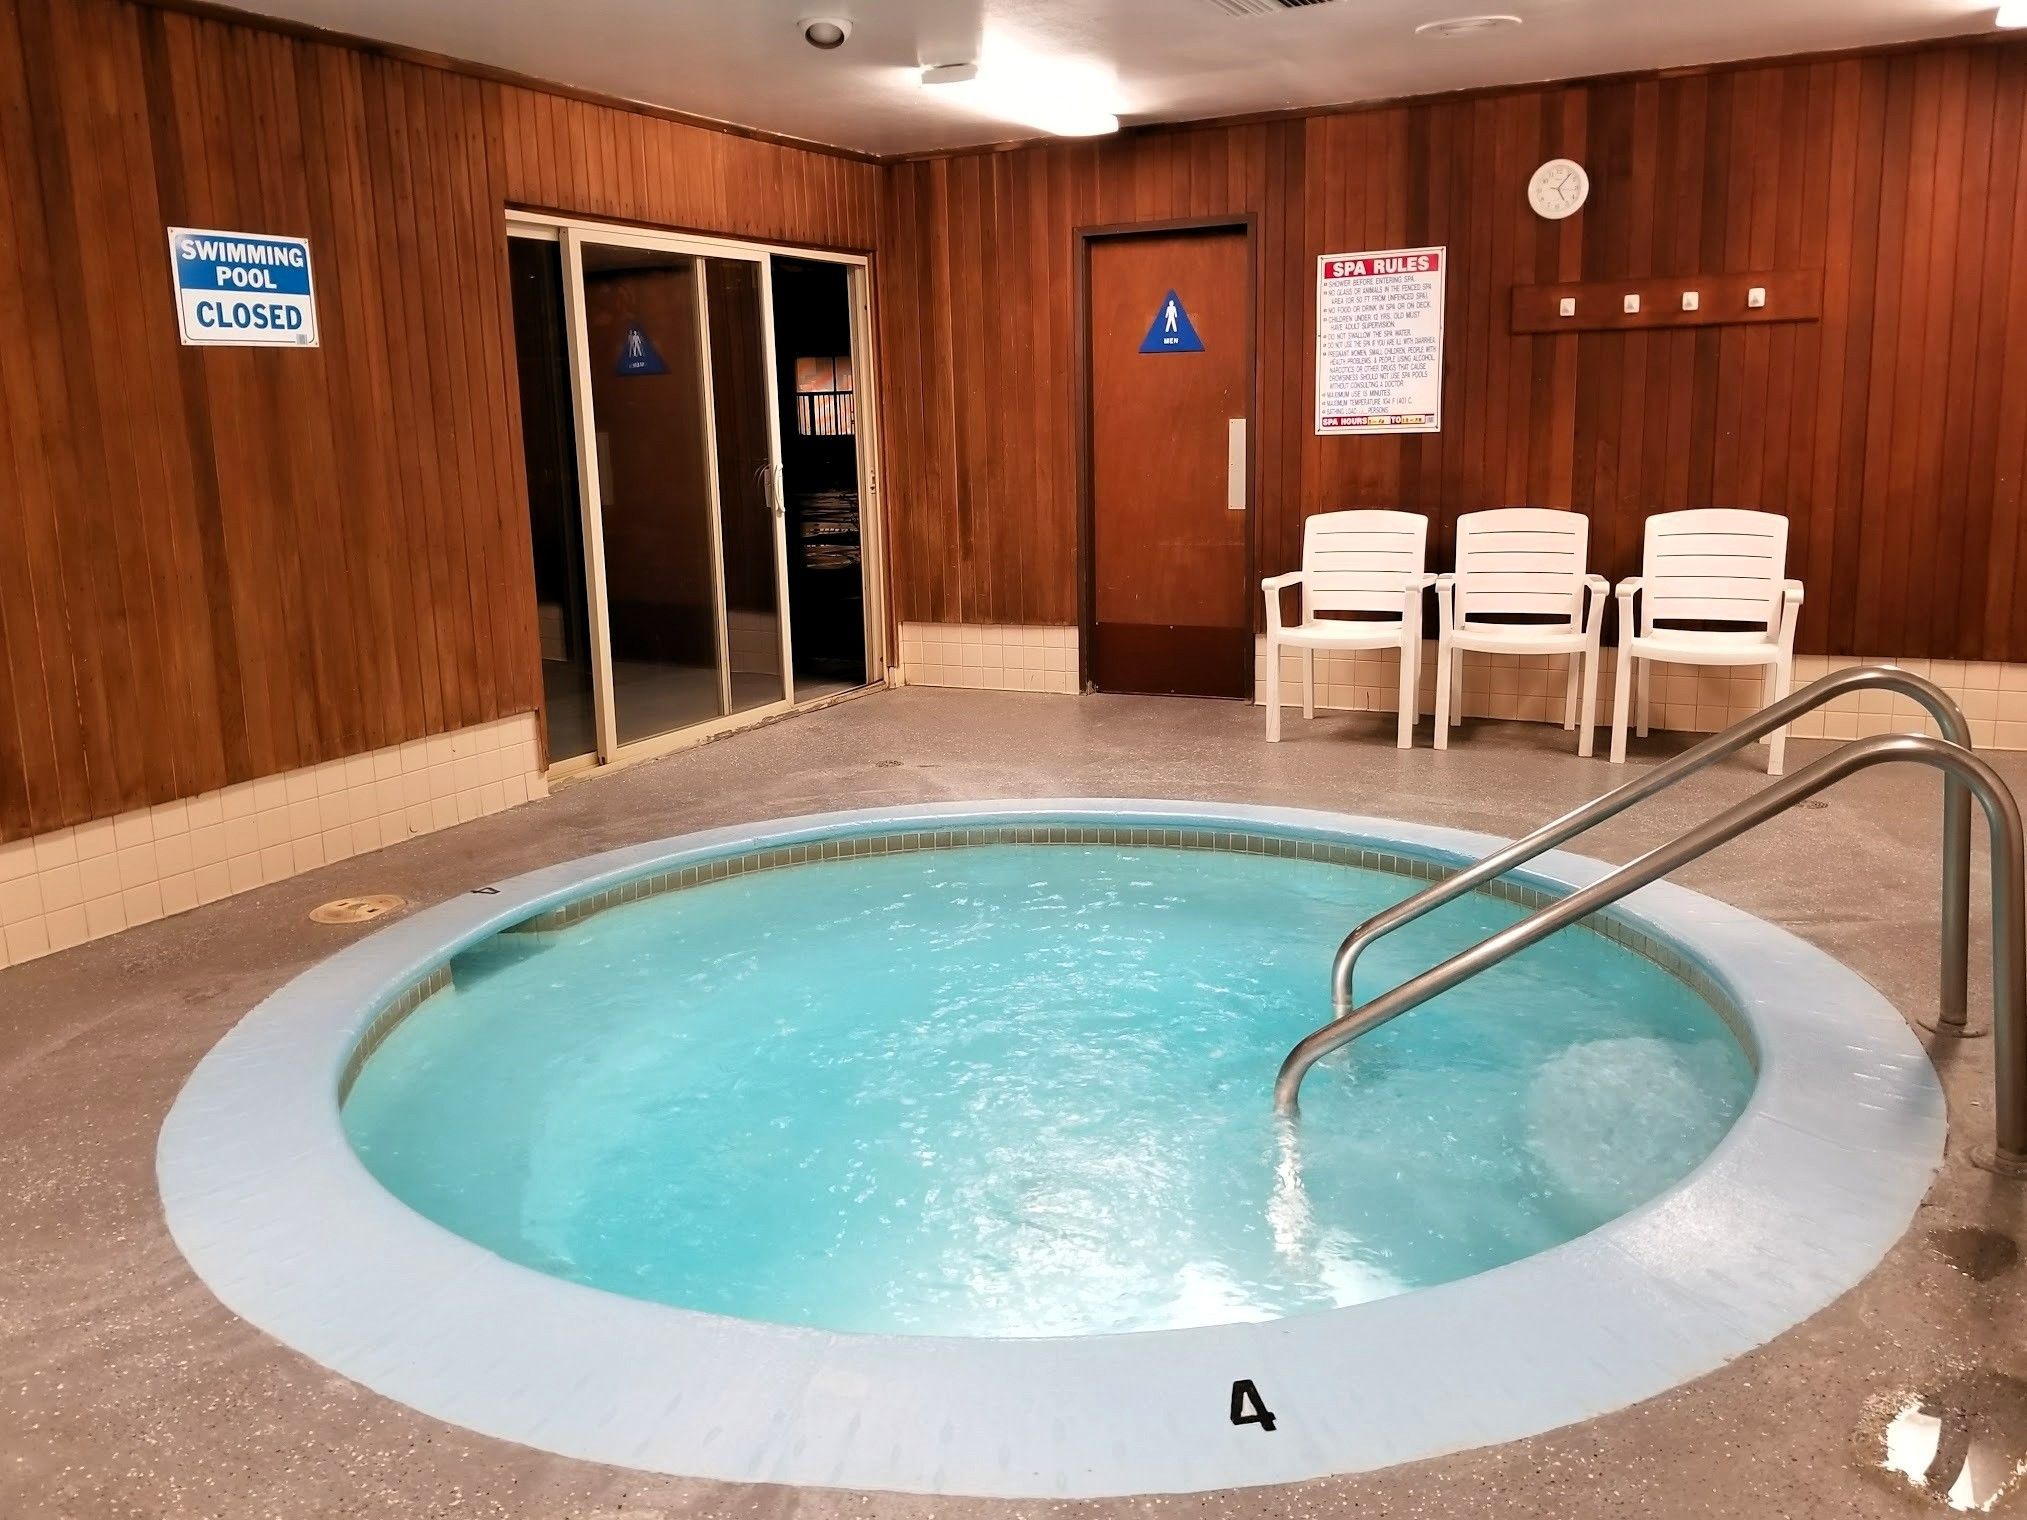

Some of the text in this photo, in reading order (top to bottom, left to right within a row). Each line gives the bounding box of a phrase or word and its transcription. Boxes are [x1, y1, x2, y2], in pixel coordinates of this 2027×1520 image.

[181, 239, 304, 267] SWIMMING
[1333, 256, 1429, 277] SPA RULES
[216, 266, 277, 289] POOL
[1353, 278, 1373, 286] BEFORE
[1376, 276, 1401, 284] ENTERING
[197, 300, 302, 330] CLOSED
[1331, 323, 1342, 331] HAVE
[1348, 331, 1370, 339] SWALLOW
[1391, 371, 1399, 379] USE
[1350, 398, 1380, 406] TEMPERATURE
[1340, 417, 1367, 425] HOURS
[1391, 416, 1401, 424] TO
[1230, 1379, 1277, 1431] 4
